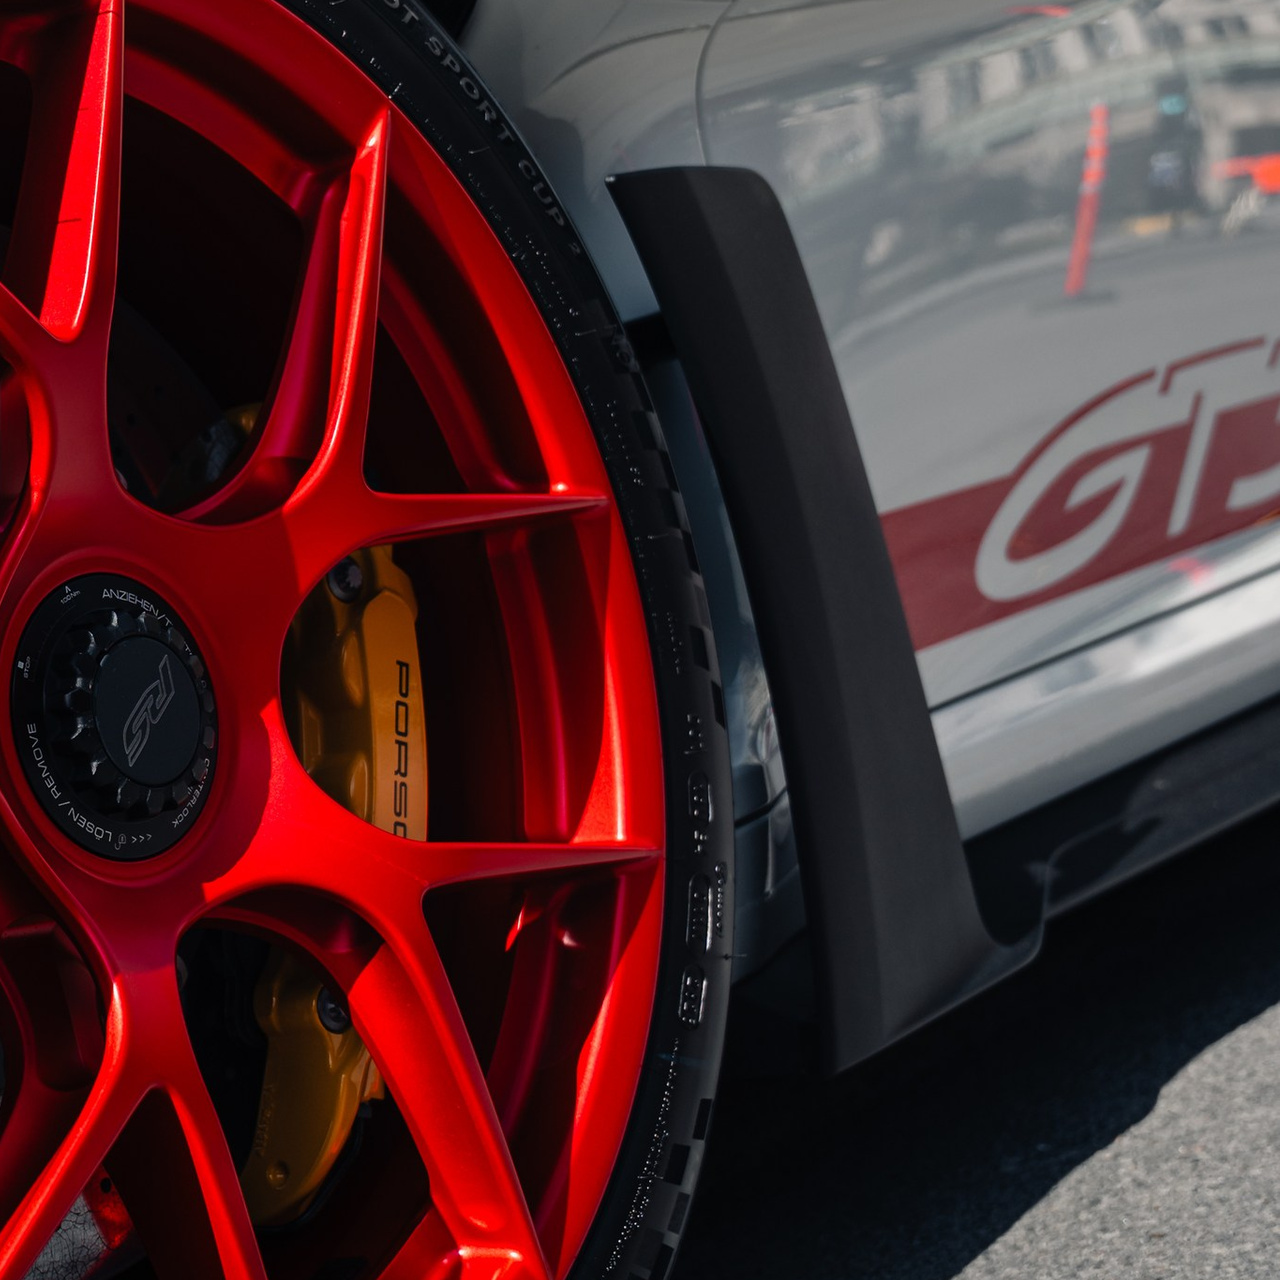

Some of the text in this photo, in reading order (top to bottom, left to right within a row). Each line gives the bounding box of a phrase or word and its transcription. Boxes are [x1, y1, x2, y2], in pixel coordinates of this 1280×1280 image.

[424, 35, 518, 147] SPORT
[517, 159, 566, 229] CUP
[570, 241, 581, 256] 2
[22, 655, 31, 679] STOP
[26, 722, 61, 801] REMOVE
[170, 757, 209, 828] CTERLOCK
[68, 806, 112, 842] LÖSEN
